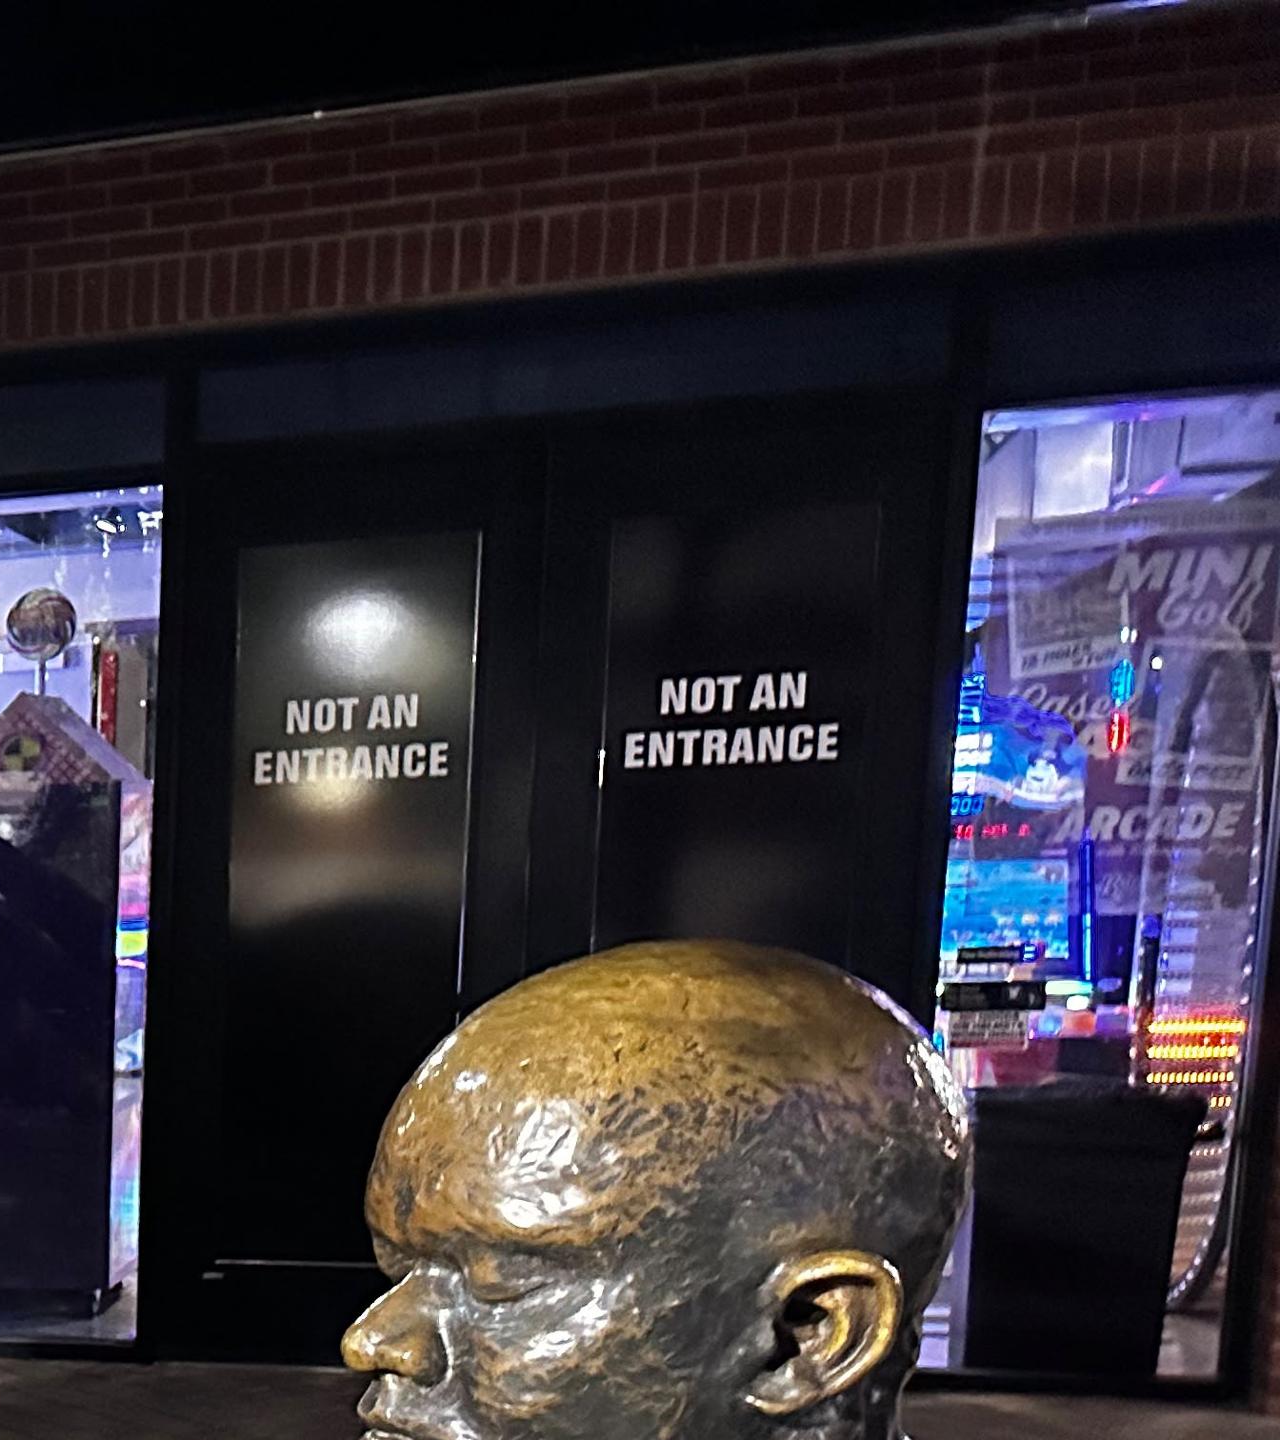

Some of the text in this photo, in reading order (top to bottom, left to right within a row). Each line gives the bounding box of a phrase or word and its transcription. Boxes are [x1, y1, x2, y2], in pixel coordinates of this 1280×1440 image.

[1107, 543, 1274, 600] MINI
[286, 693, 419, 735] NOT AN
[660, 671, 808, 715] NOT AN
[254, 742, 448, 785] ENTRANCE
[624, 722, 839, 768] ENTRANCE
[1049, 802, 1245, 844] ARCADE
